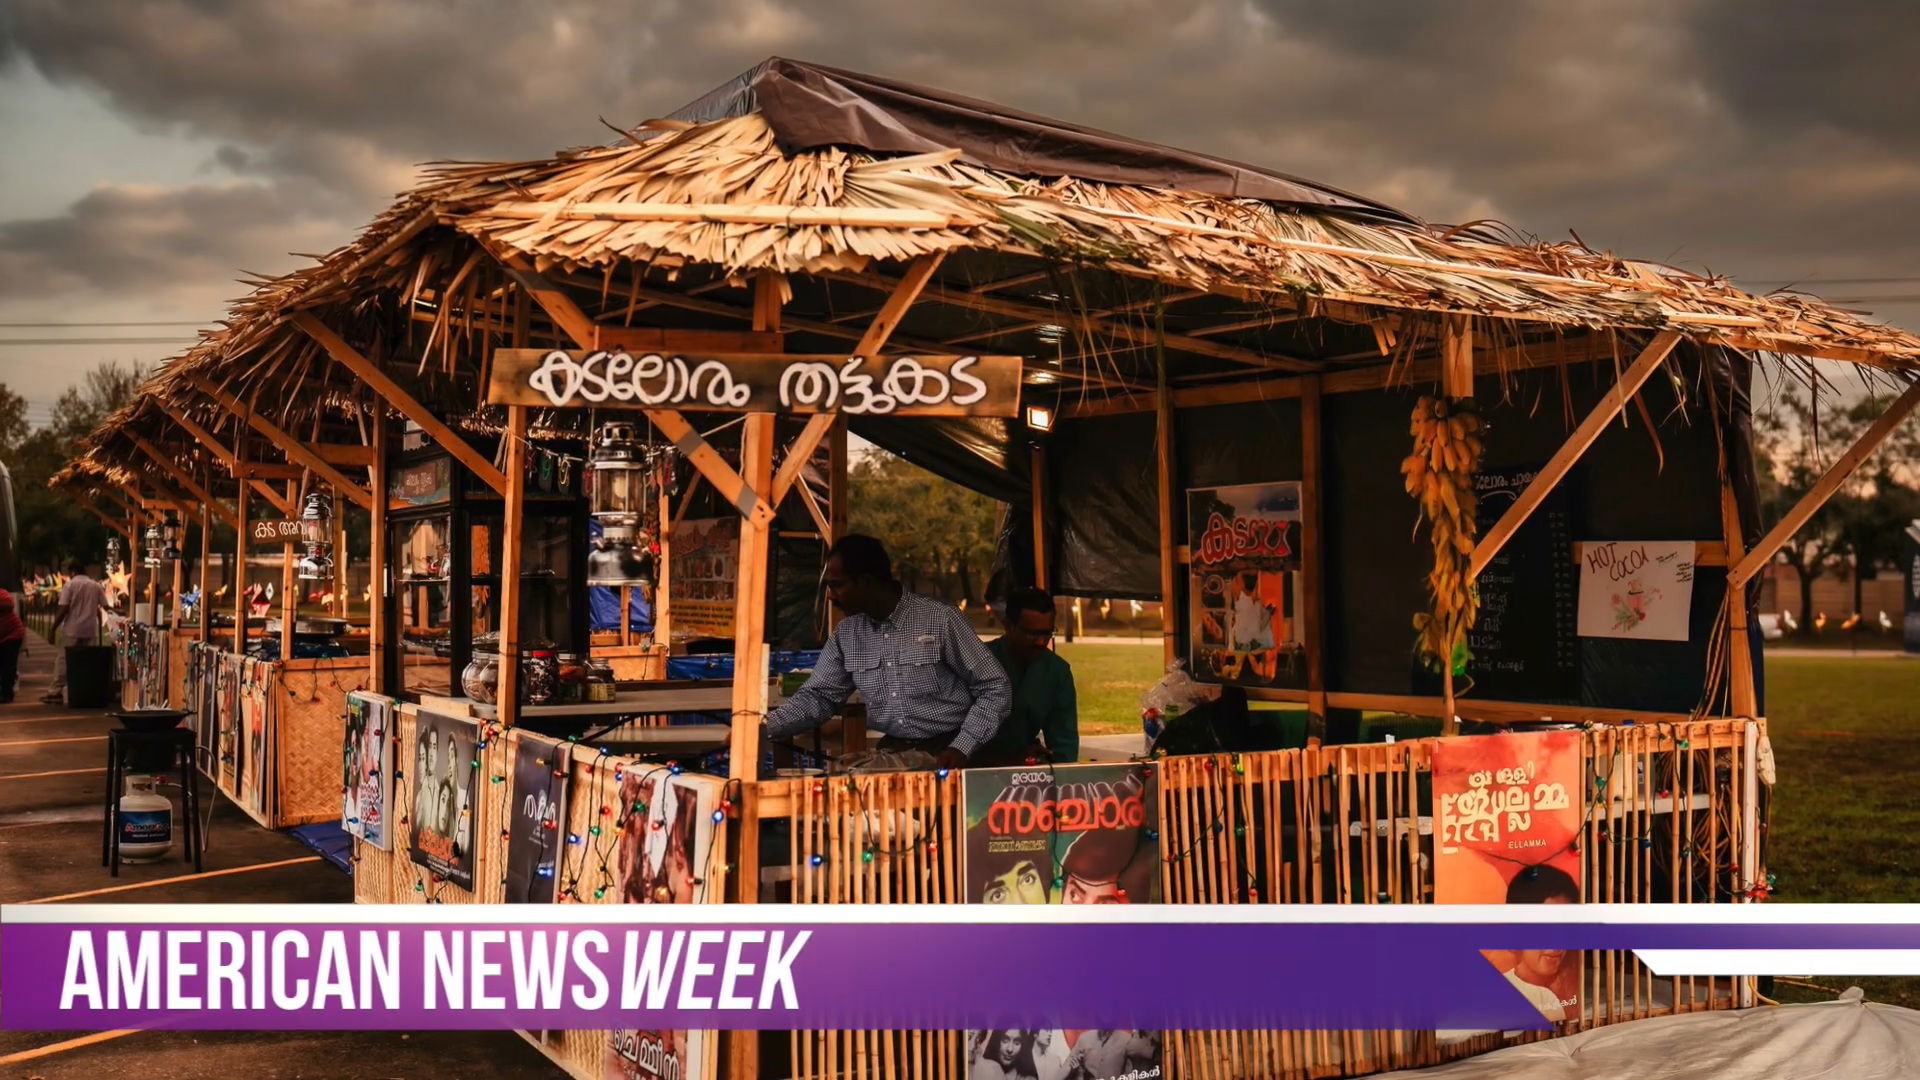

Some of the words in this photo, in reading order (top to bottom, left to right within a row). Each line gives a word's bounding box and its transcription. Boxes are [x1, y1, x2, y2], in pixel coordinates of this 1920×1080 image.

[529, 350, 750, 407] കടലോരം
[779, 356, 988, 414] തട്ടുകട
[255, 522, 276, 538] കട
[1586, 542, 1617, 574] HOT
[1609, 545, 1650, 582] COCOA
[1508, 839, 1547, 849] ELLAMMA
